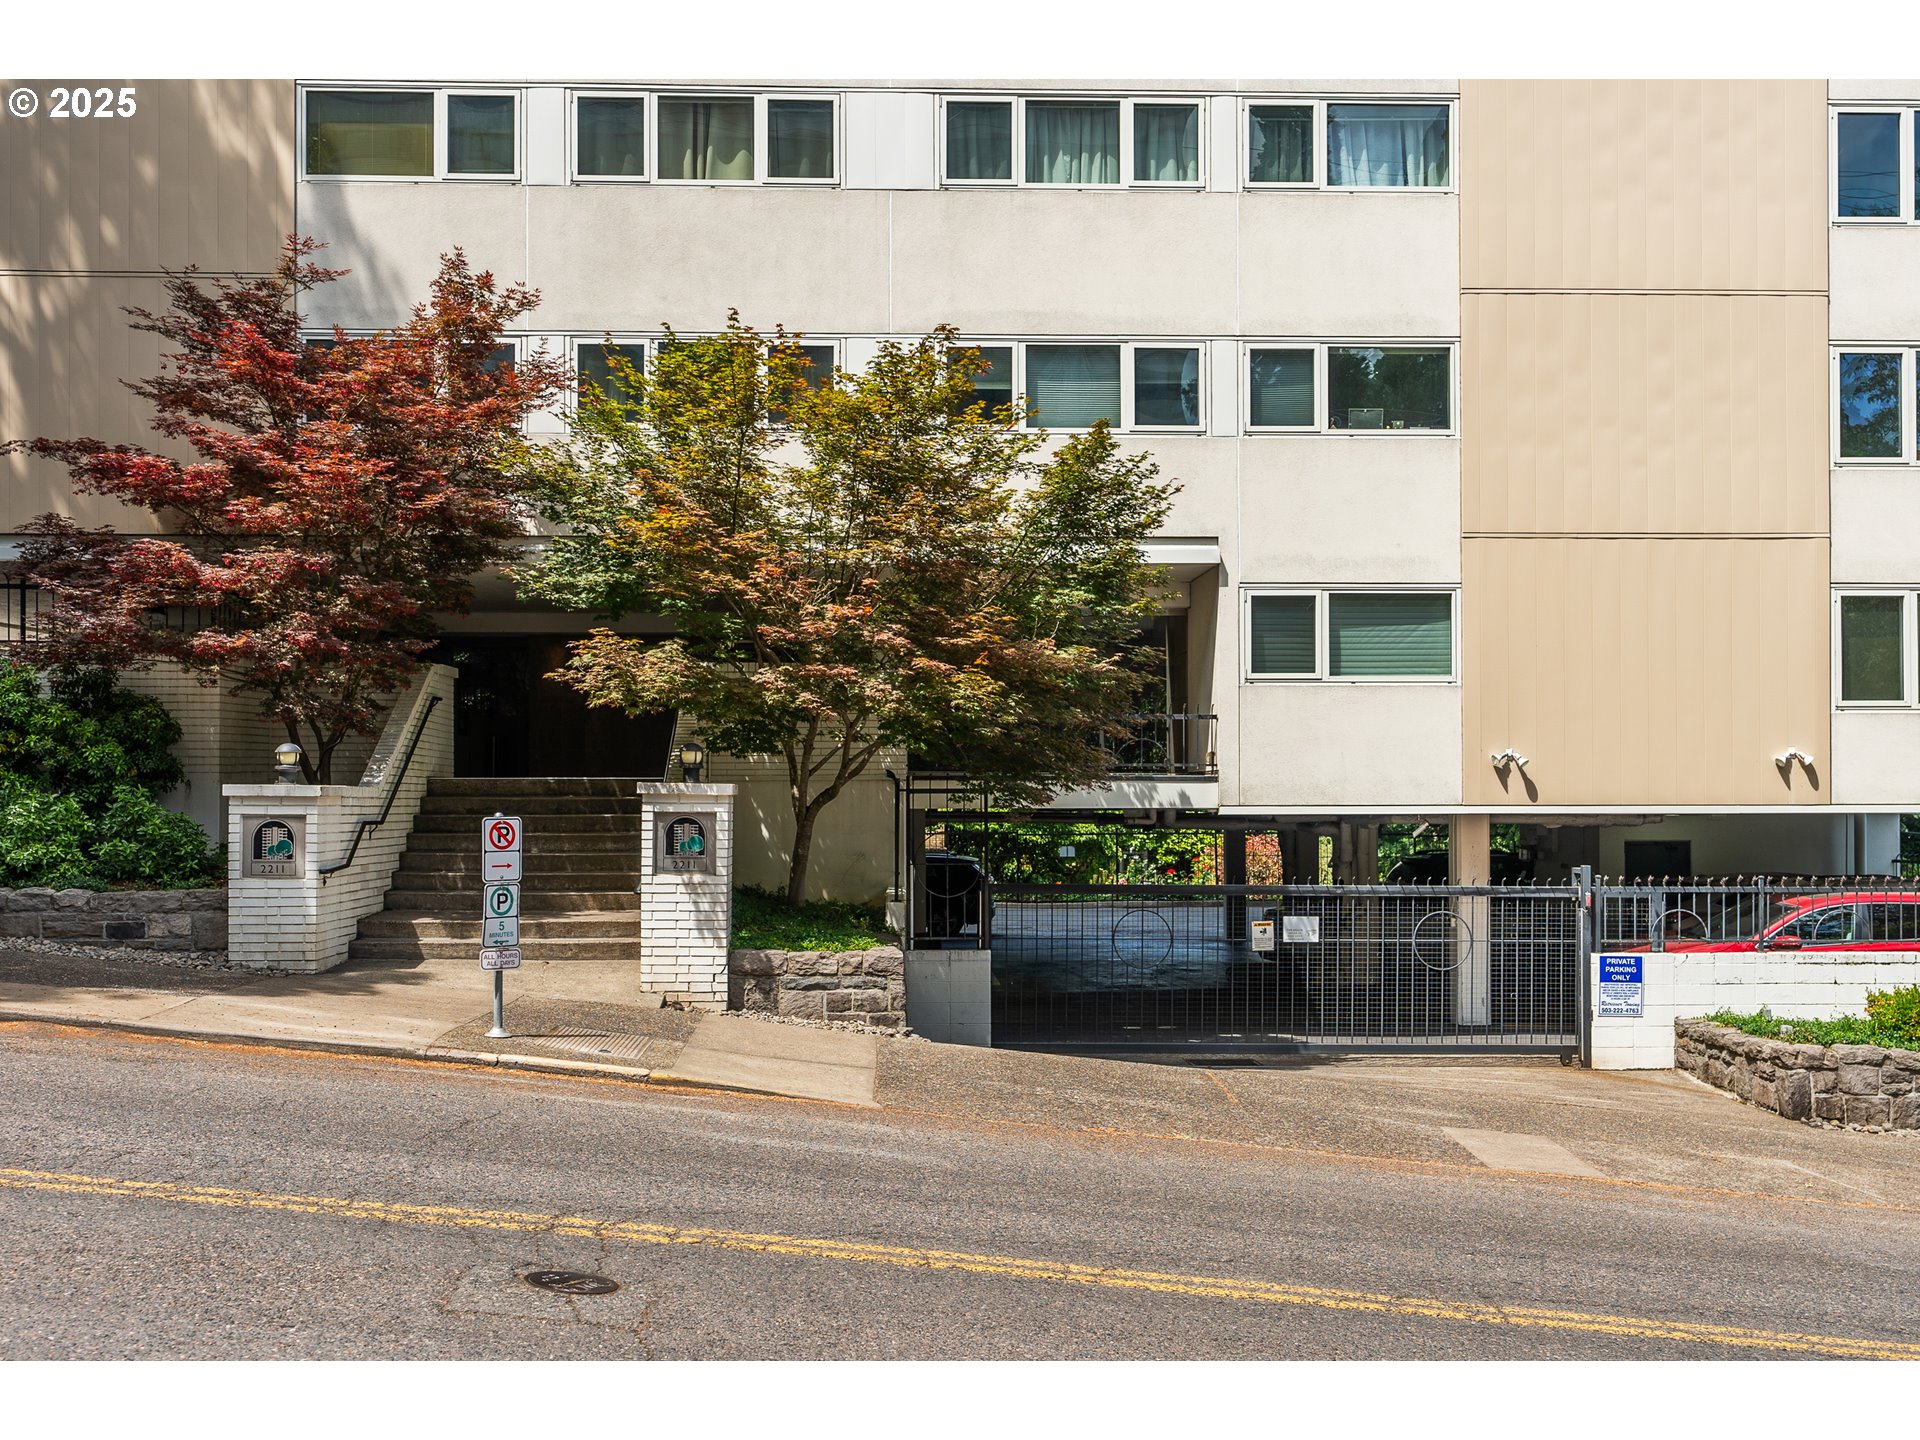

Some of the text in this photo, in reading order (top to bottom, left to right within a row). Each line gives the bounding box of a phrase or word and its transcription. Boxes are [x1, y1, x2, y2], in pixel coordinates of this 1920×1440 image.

[497, 826, 510, 844] P
[260, 864, 285, 874] 2211
[672, 860, 696, 869] 2211
[496, 893, 508, 910] P
[498, 921, 505, 931] 5
